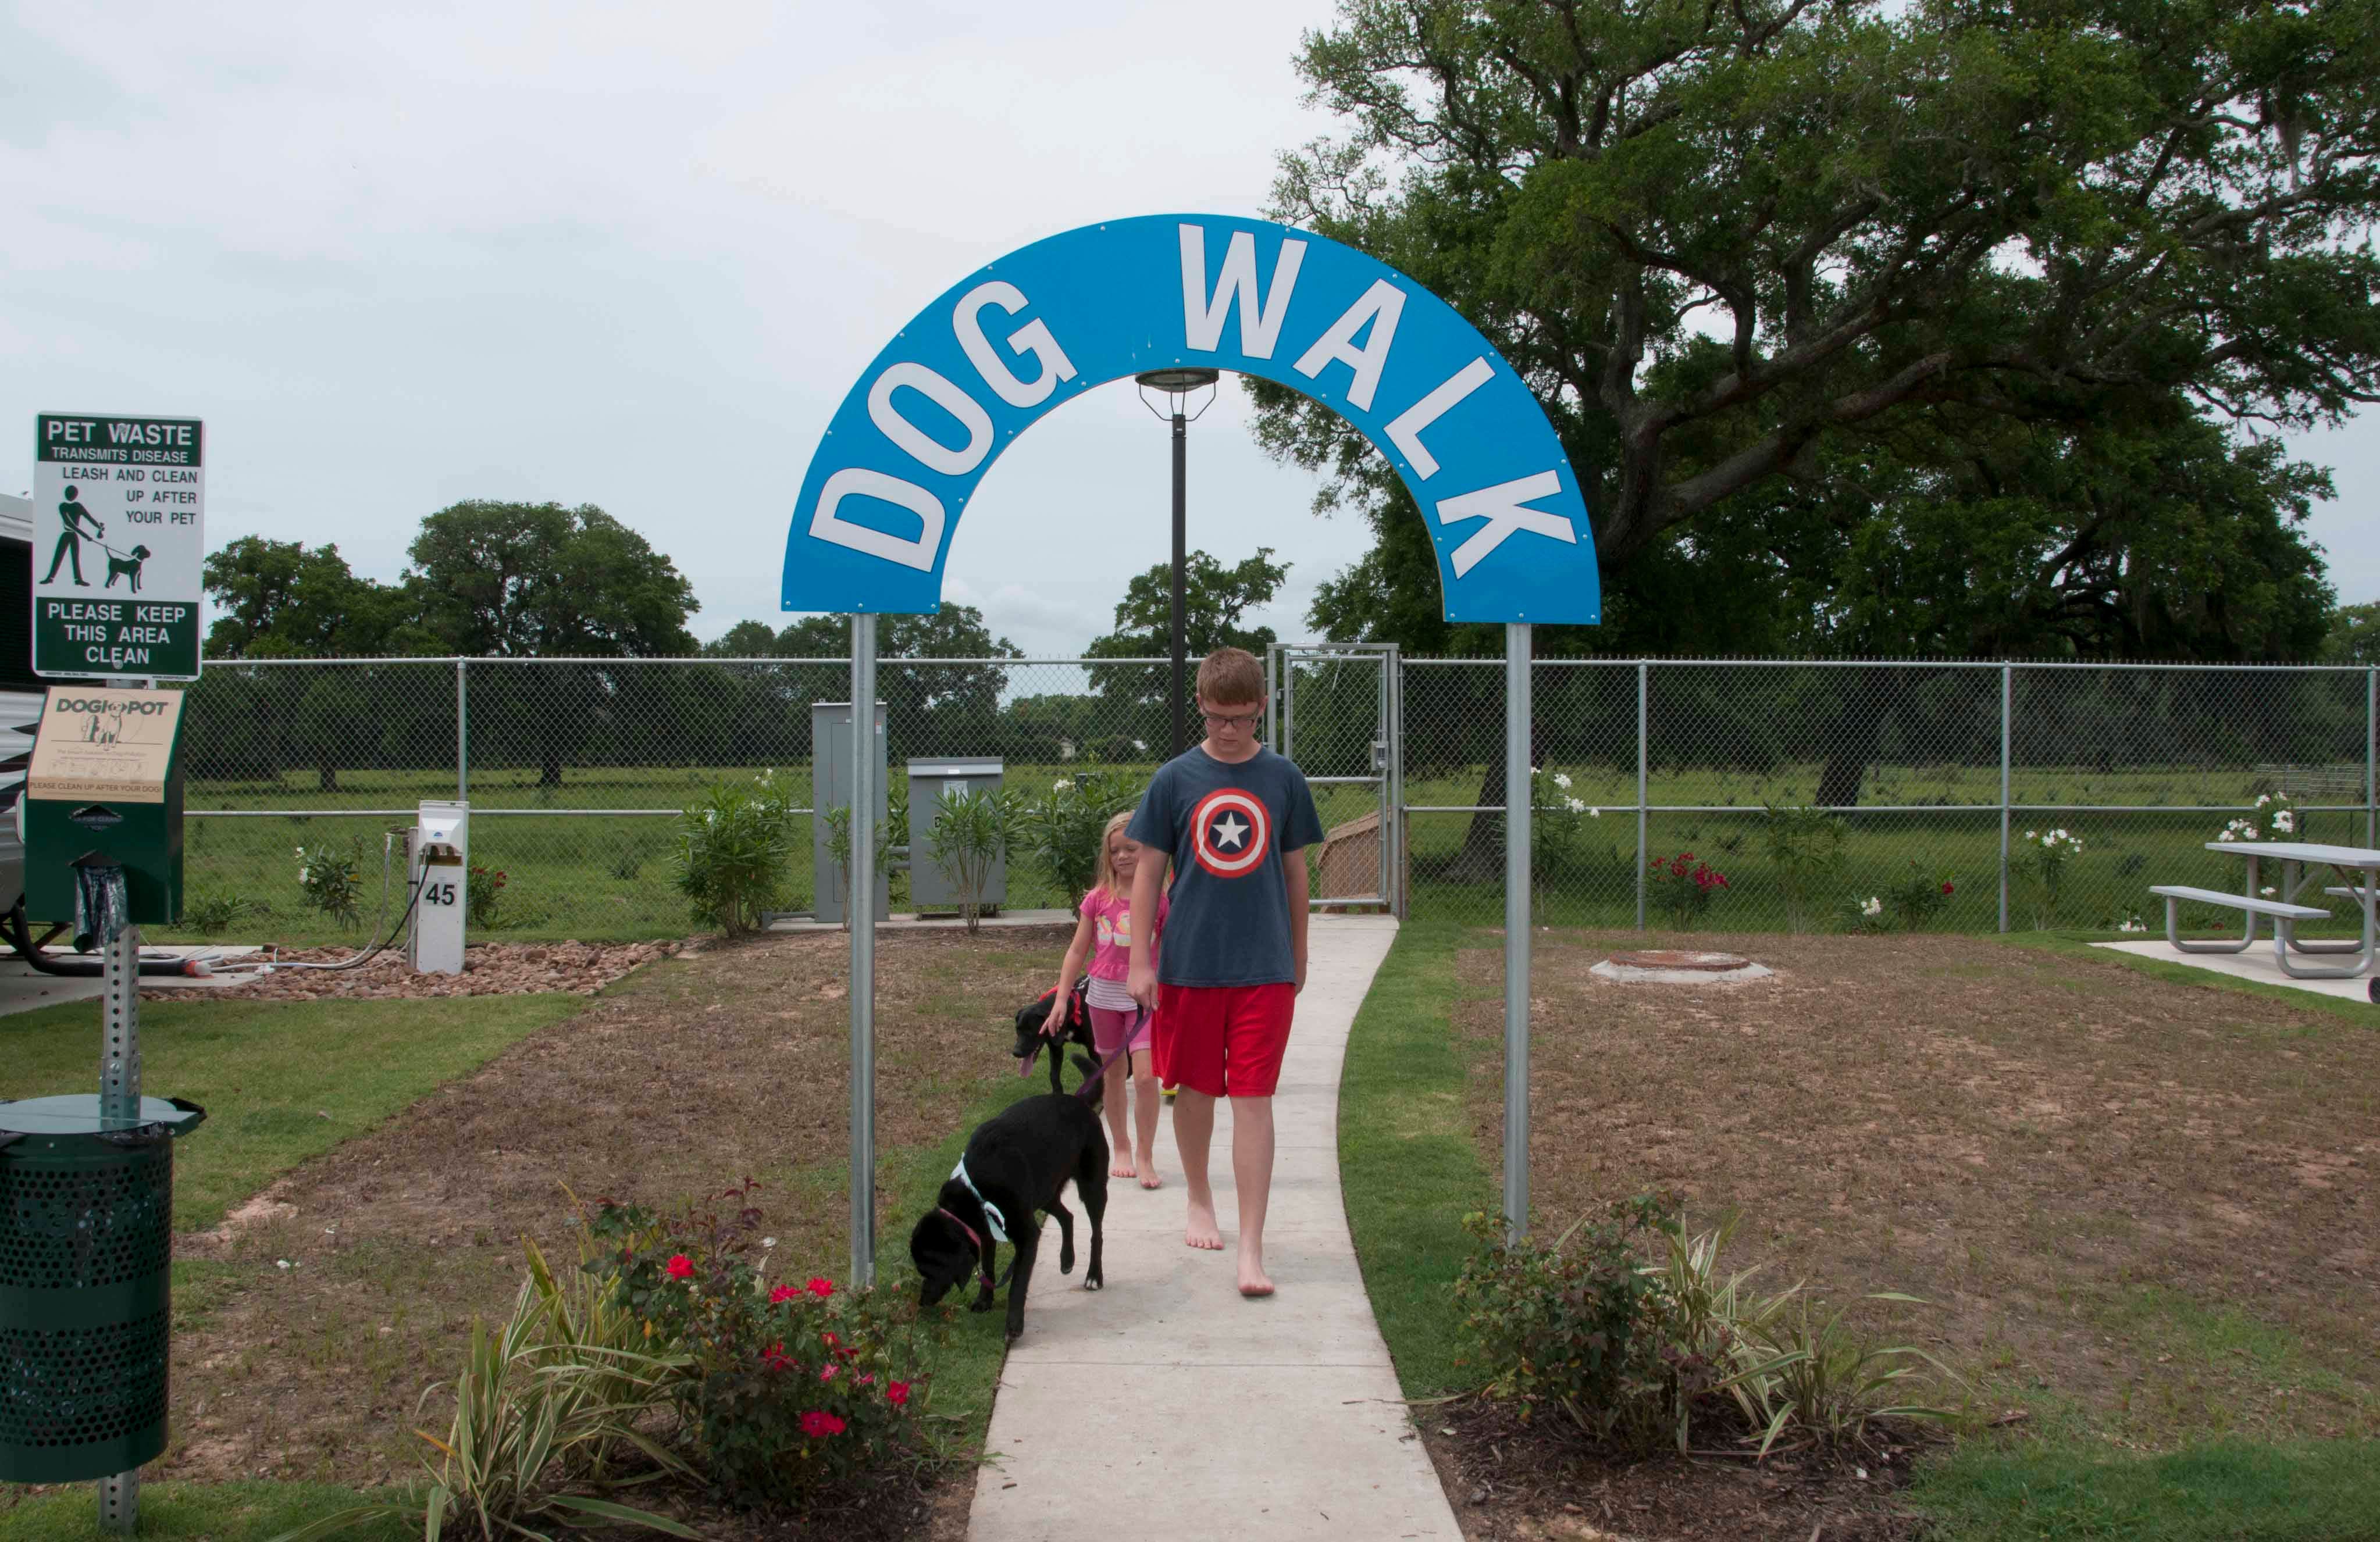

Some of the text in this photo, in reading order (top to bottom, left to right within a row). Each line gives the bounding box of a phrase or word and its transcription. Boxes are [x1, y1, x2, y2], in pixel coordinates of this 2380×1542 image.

[808, 223, 1577, 580] DOG WALK
[48, 420, 193, 445] PET WASTE
[52, 447, 188, 463] TRANSMITS DISEASE
[63, 467, 197, 483] LEASH AND CLEAN
[127, 490, 197, 504] UP AFTER
[126, 511, 196, 524] YOUR PET
[48, 602, 186, 623] PLEASE KEEP
[64, 624, 170, 644] THIS AREA
[85, 647, 149, 664] CLEAN
[425, 883, 455, 906] 45
